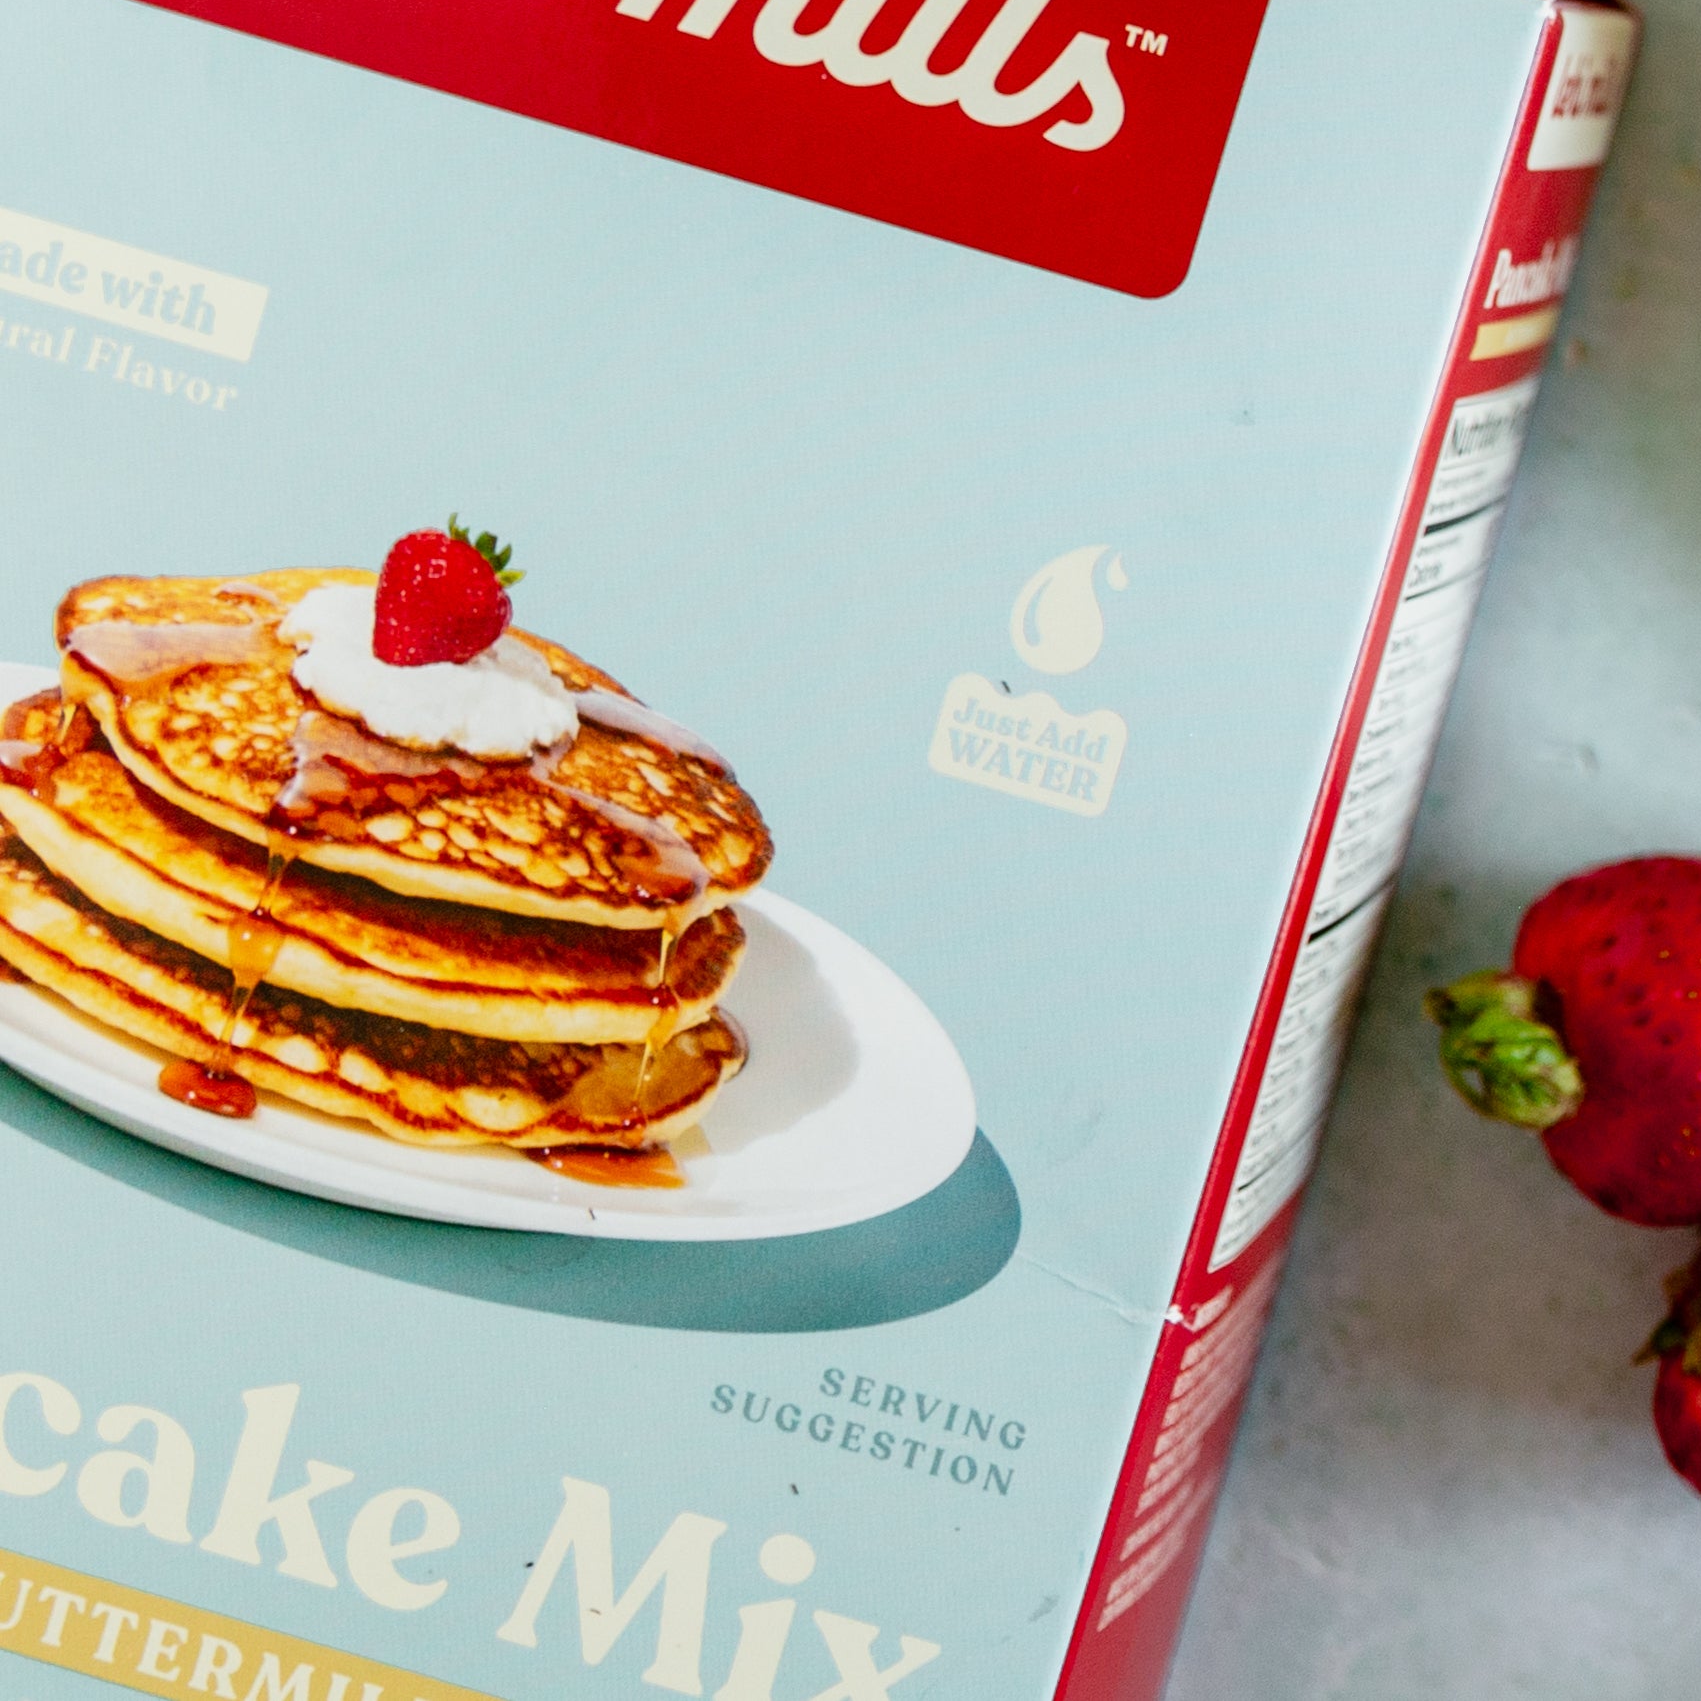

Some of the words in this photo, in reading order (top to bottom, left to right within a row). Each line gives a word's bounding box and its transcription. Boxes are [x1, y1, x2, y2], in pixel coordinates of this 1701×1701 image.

[99, 269, 218, 336] with
[84, 334, 240, 412] Flavor
[947, 726, 1101, 803] WATER
[952, 696, 1034, 742] Just
[1034, 720, 1110, 765] Add
[709, 1383, 1016, 1497] SUGGESTION
[818, 1367, 1027, 1451] SERVING
[0, 1369, 462, 1612] cake
[494, 1475, 942, 1701] Mix
